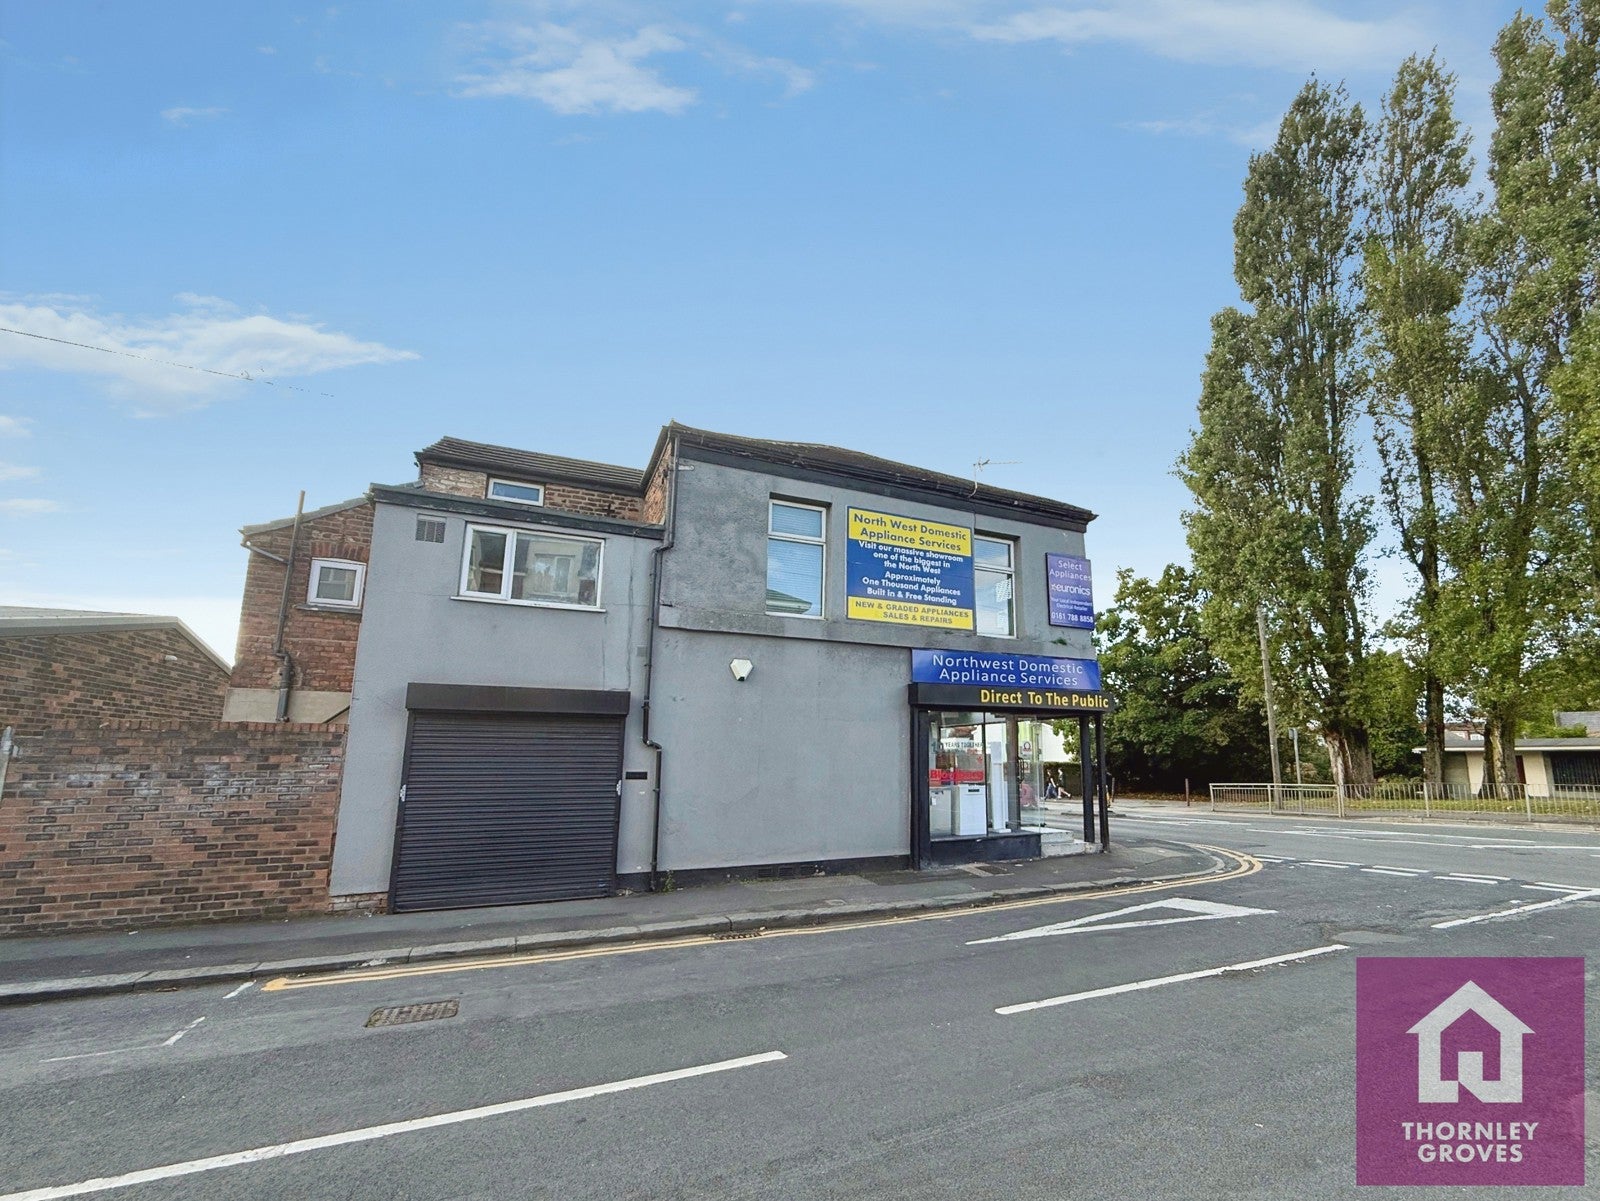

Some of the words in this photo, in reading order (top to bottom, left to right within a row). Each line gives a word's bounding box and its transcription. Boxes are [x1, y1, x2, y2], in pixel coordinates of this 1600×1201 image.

[854, 513, 887, 527] North
[890, 519, 917, 532] West
[920, 525, 966, 540] Domestic
[860, 528, 915, 544] Appliance
[919, 536, 961, 551] Services
[858, 540, 876, 549] Visit
[894, 547, 924, 556] massive
[926, 552, 963, 562] showroom
[899, 562, 920, 572] North
[922, 565, 941, 574] West
[914, 557, 941, 568] biggest
[943, 560, 950, 568] in
[1058, 560, 1082, 571] Select
[885, 571, 941, 586] Approximately
[1049, 569, 1092, 581] Appliances
[862, 577, 879, 585] One
[881, 579, 918, 591] Thousand
[920, 584, 960, 596] Appliances
[1057, 584, 1091, 596] euronics
[867, 587, 885, 596] Built
[905, 592, 922, 601] Free
[924, 593, 957, 606] Standing
[855, 601, 875, 609] NEW
[886, 603, 919, 613] GRADED
[921, 608, 969, 618] APPLIANCES
[883, 611, 909, 620] SALES
[920, 616, 953, 624] REPAIRS
[1051, 612, 1066, 620] 0161
[933, 654, 1014, 671] Northwest
[1019, 660, 1083, 674] Domestic
[939, 668, 1016, 683] Appliance
[1020, 672, 1078, 686] Services
[980, 689, 1022, 704] Direct
[1028, 691, 1043, 705] To
[1045, 692, 1069, 706] The
[1072, 694, 1109, 708] Public
